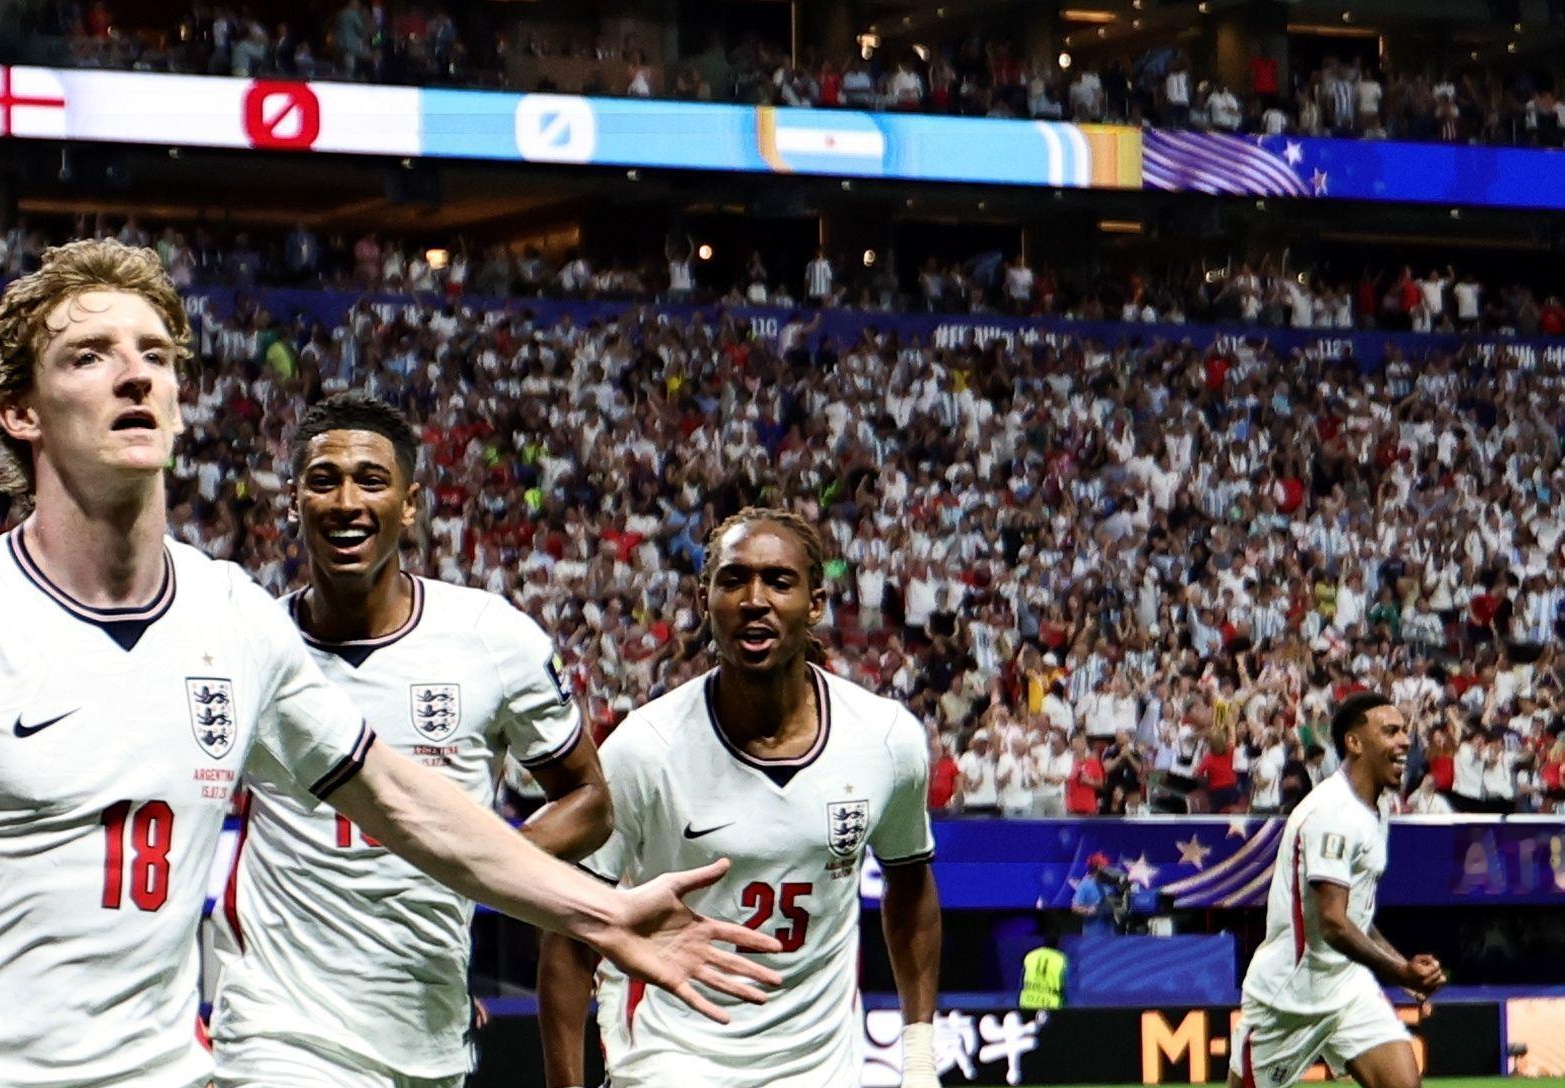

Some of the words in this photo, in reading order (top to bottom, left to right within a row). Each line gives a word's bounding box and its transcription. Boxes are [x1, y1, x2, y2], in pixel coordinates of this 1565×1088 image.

[243, 79, 320, 151] 0
[515, 93, 598, 164] 0
[100, 799, 174, 912] 18
[736, 881, 813, 953] 25
